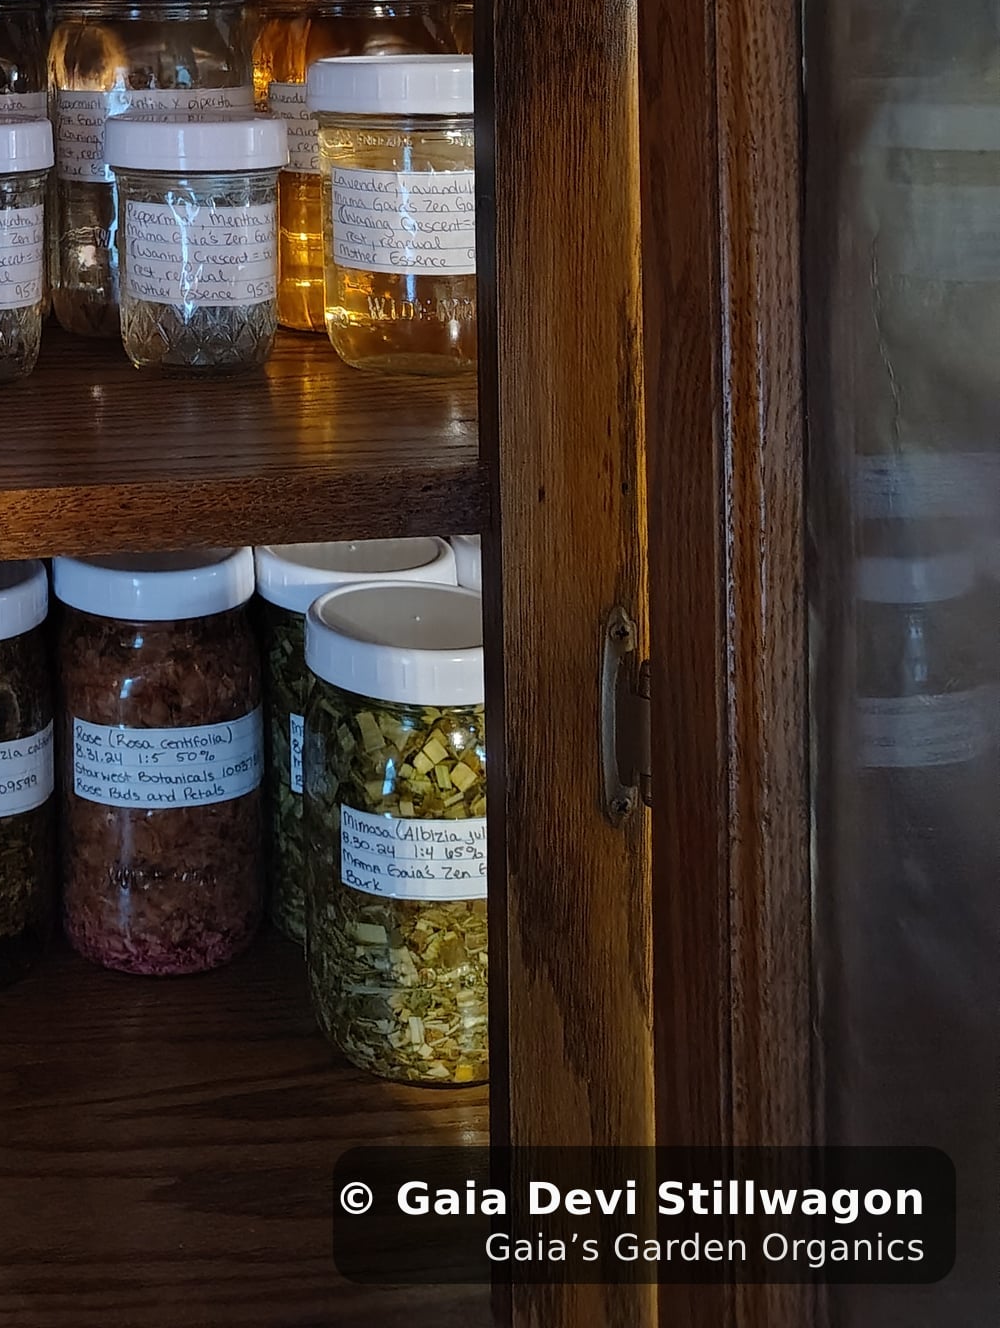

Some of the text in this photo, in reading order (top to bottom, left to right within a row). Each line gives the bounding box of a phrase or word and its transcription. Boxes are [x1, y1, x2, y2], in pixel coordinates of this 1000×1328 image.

[333, 173, 399, 197] Lavender,
[372, 201, 417, 214] Gaia's
[422, 199, 451, 213] Zen
[8, 232, 29, 245] Zen
[224, 232, 248, 246] Zen
[379, 237, 442, 250] renewal
[194, 254, 249, 265] Crescent
[389, 251, 447, 267] Essence
[76, 726, 102, 747] Rose
[138, 751, 166, 765] 1:5
[176, 750, 215, 762] 50%
[138, 770, 215, 785] Botanicals
[76, 778, 226, 803] Rose Buds and Petals
[343, 811, 396, 840] Mimosa
[342, 831, 396, 859] 8.30.24
[413, 845, 434, 860] 1:4
[387, 863, 436, 880] Gaia's
[441, 865, 471, 880] Zen
[346, 869, 383, 892] Bark
